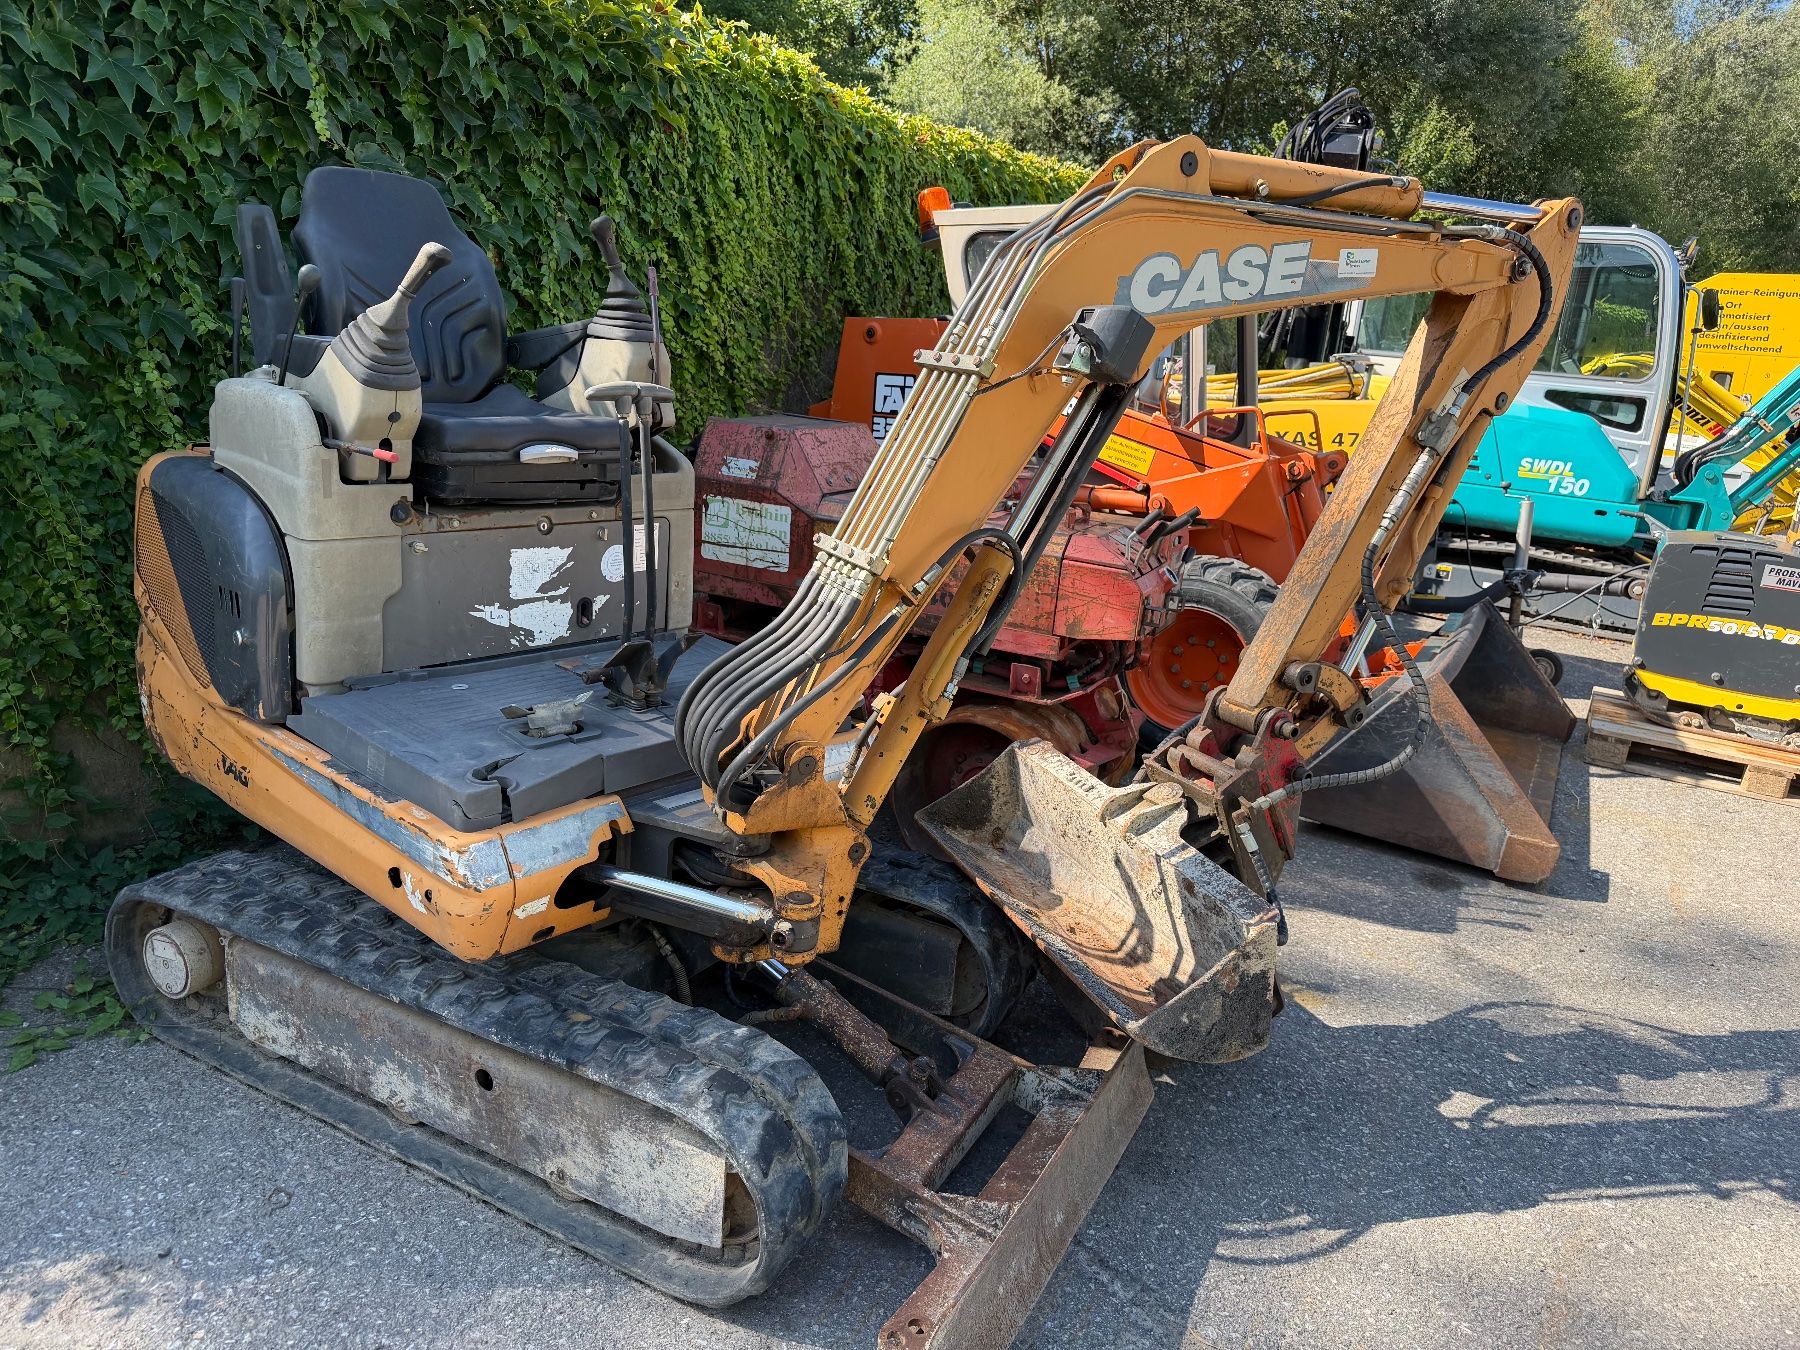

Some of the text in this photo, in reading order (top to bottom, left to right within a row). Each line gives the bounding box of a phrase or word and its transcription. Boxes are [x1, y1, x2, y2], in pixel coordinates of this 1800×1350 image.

[1130, 240, 1311, 314] CASE
[1701, 287, 1800, 299] Ctainer-Reinigun
[1725, 301, 1742, 309] Ort
[1696, 342, 1783, 353] umweltschonend
[1518, 457, 1575, 477] SWDL
[1548, 476, 1590, 496] 150
[1651, 613, 1708, 630] BPR
